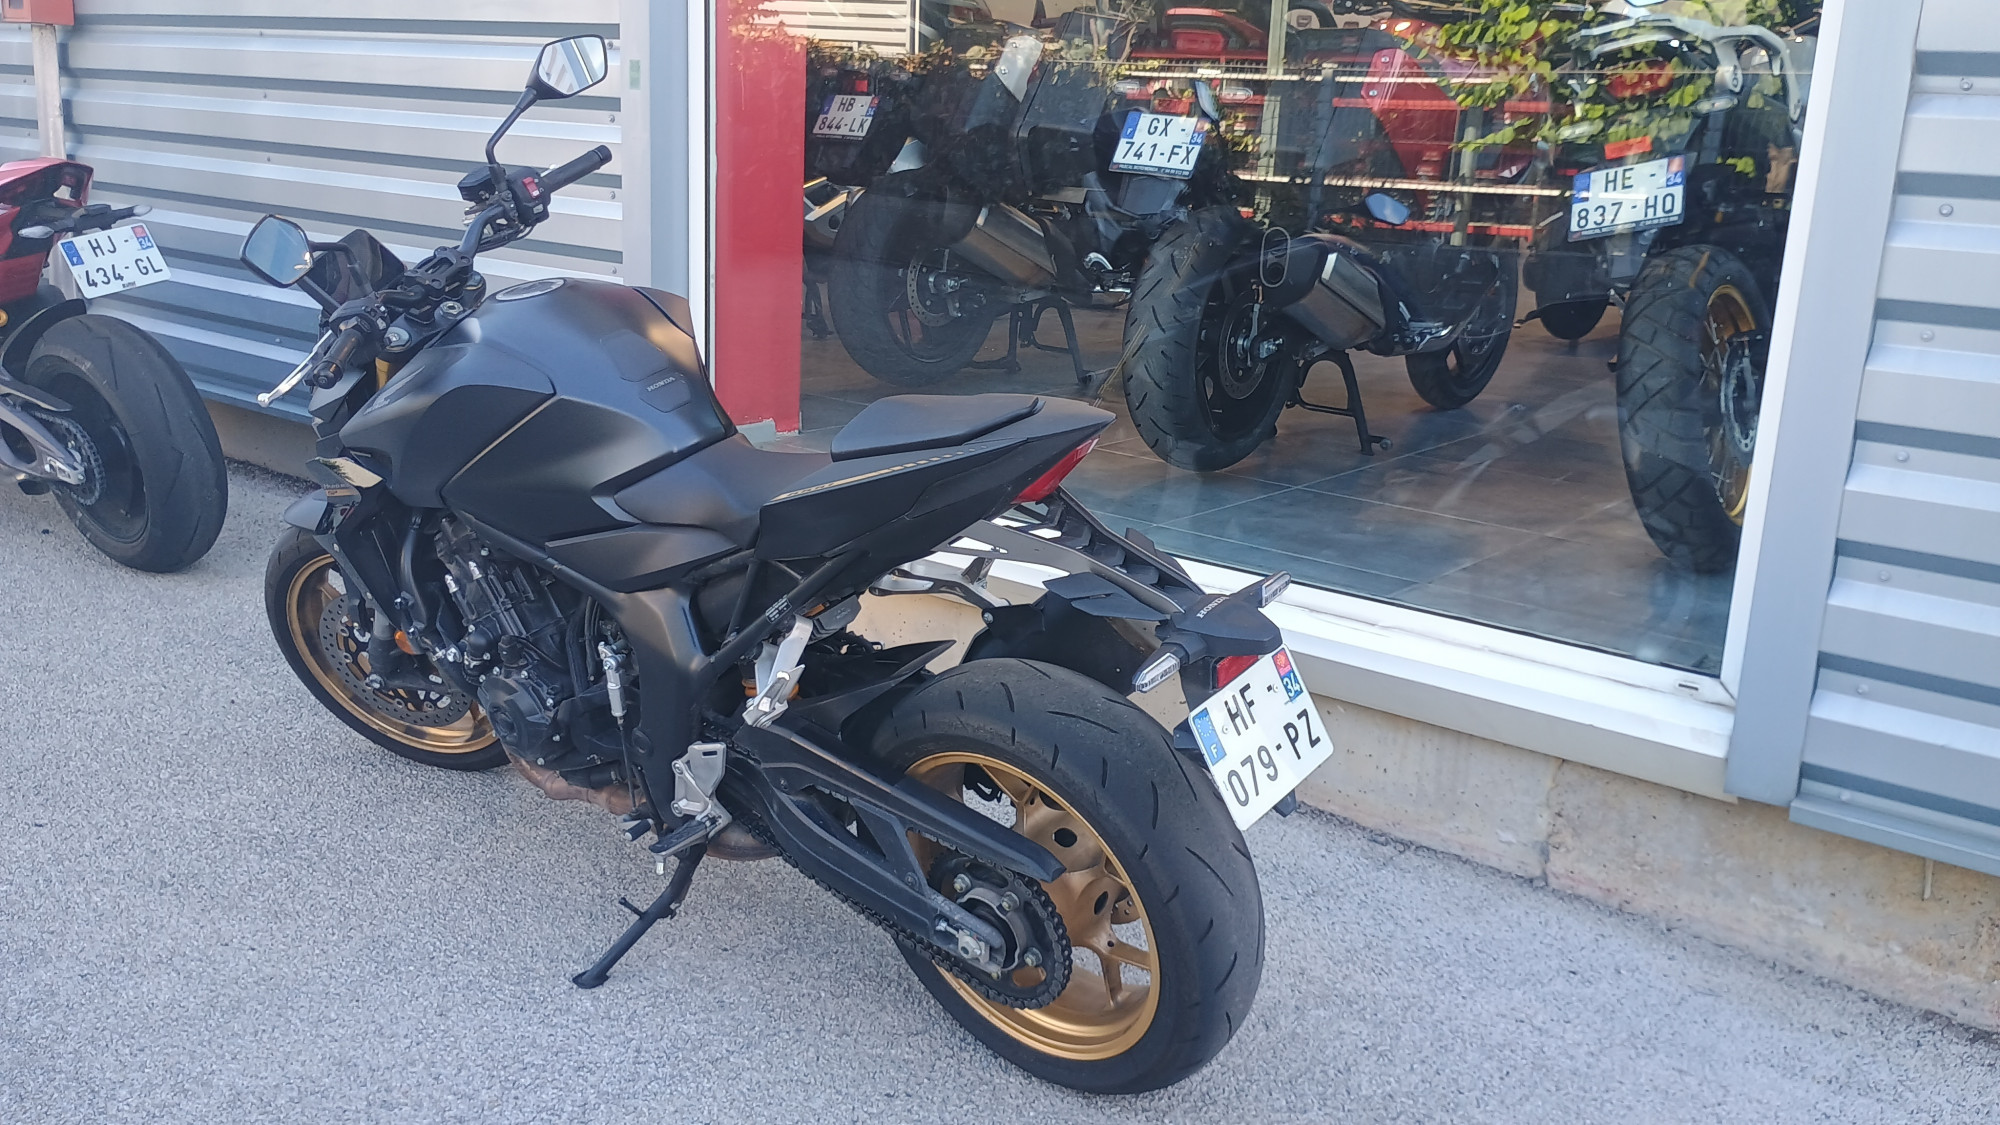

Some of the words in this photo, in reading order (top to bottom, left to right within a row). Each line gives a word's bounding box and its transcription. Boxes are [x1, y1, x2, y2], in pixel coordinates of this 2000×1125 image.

[837, 98, 856, 112] HB
[819, 117, 868, 133] 844-LK
[1147, 118, 1173, 137] GX
[1191, 133, 1202, 144] 34
[1122, 141, 1194, 165] 741-FX
[1604, 168, 1634, 193] HE
[1666, 172, 1682, 185] 34
[88, 235, 116, 258] HJ
[139, 237, 152, 249] 34
[85, 256, 163, 288] 434-GL
[646, 377, 676, 392] HONDA
[1283, 677, 1300, 697] 34
[1224, 682, 1256, 736] HF
[1210, 743, 1218, 759] F
[1227, 708, 1321, 807] 079-PZ
